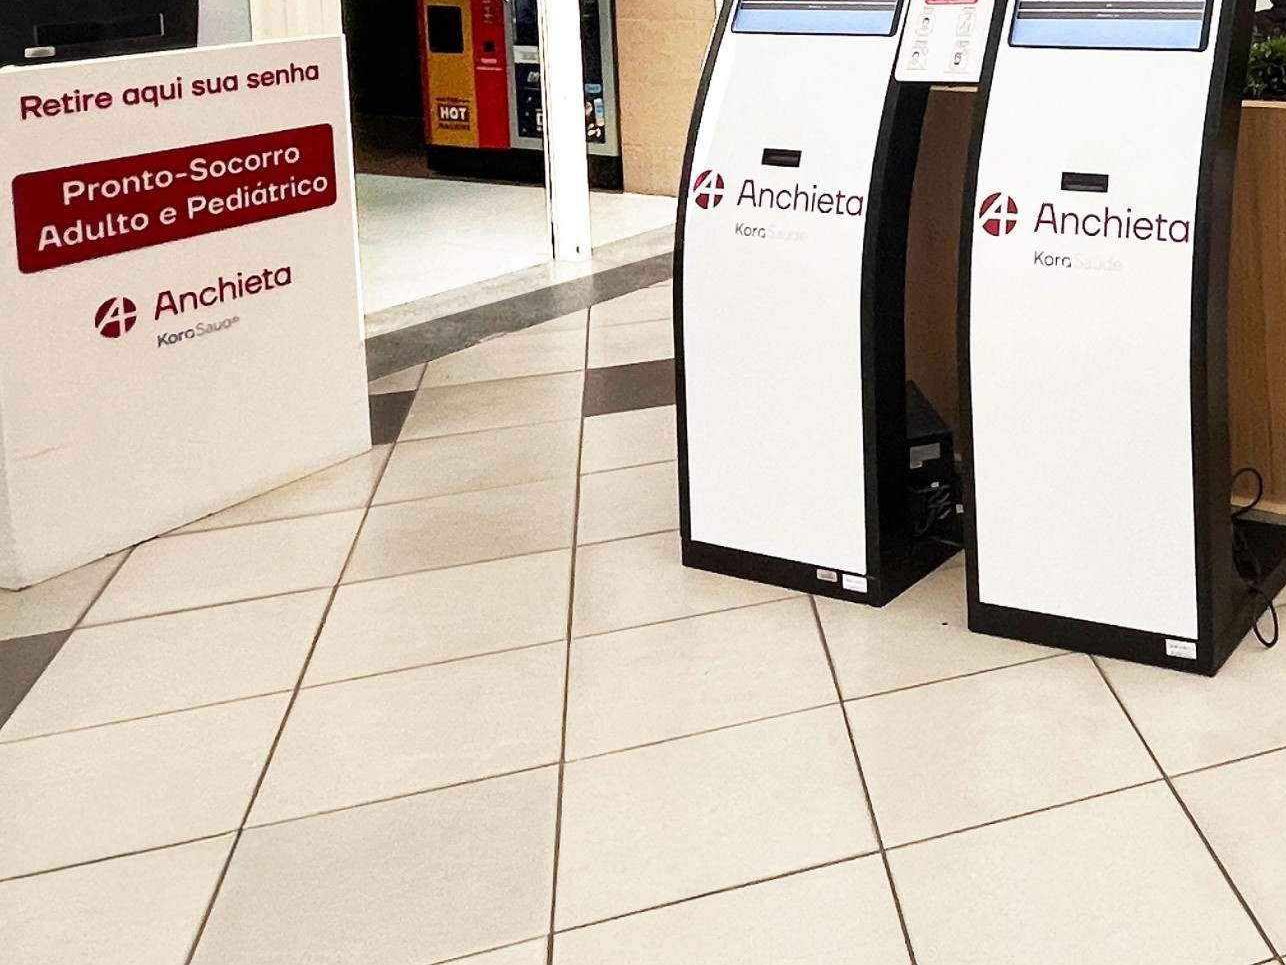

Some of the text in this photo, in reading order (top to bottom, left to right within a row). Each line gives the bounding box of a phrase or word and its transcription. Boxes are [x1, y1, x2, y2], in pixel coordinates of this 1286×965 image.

[20, 63, 320, 120] Retire aqui sua senha
[440, 106, 467, 120] HOT
[62, 145, 300, 205] Pronto-Socorro
[736, 179, 864, 217] Anchieta
[37, 176, 329, 251] Adulto e Pediátrico
[1034, 202, 1190, 243] Anchieta
[154, 266, 292, 320] Anchieta
